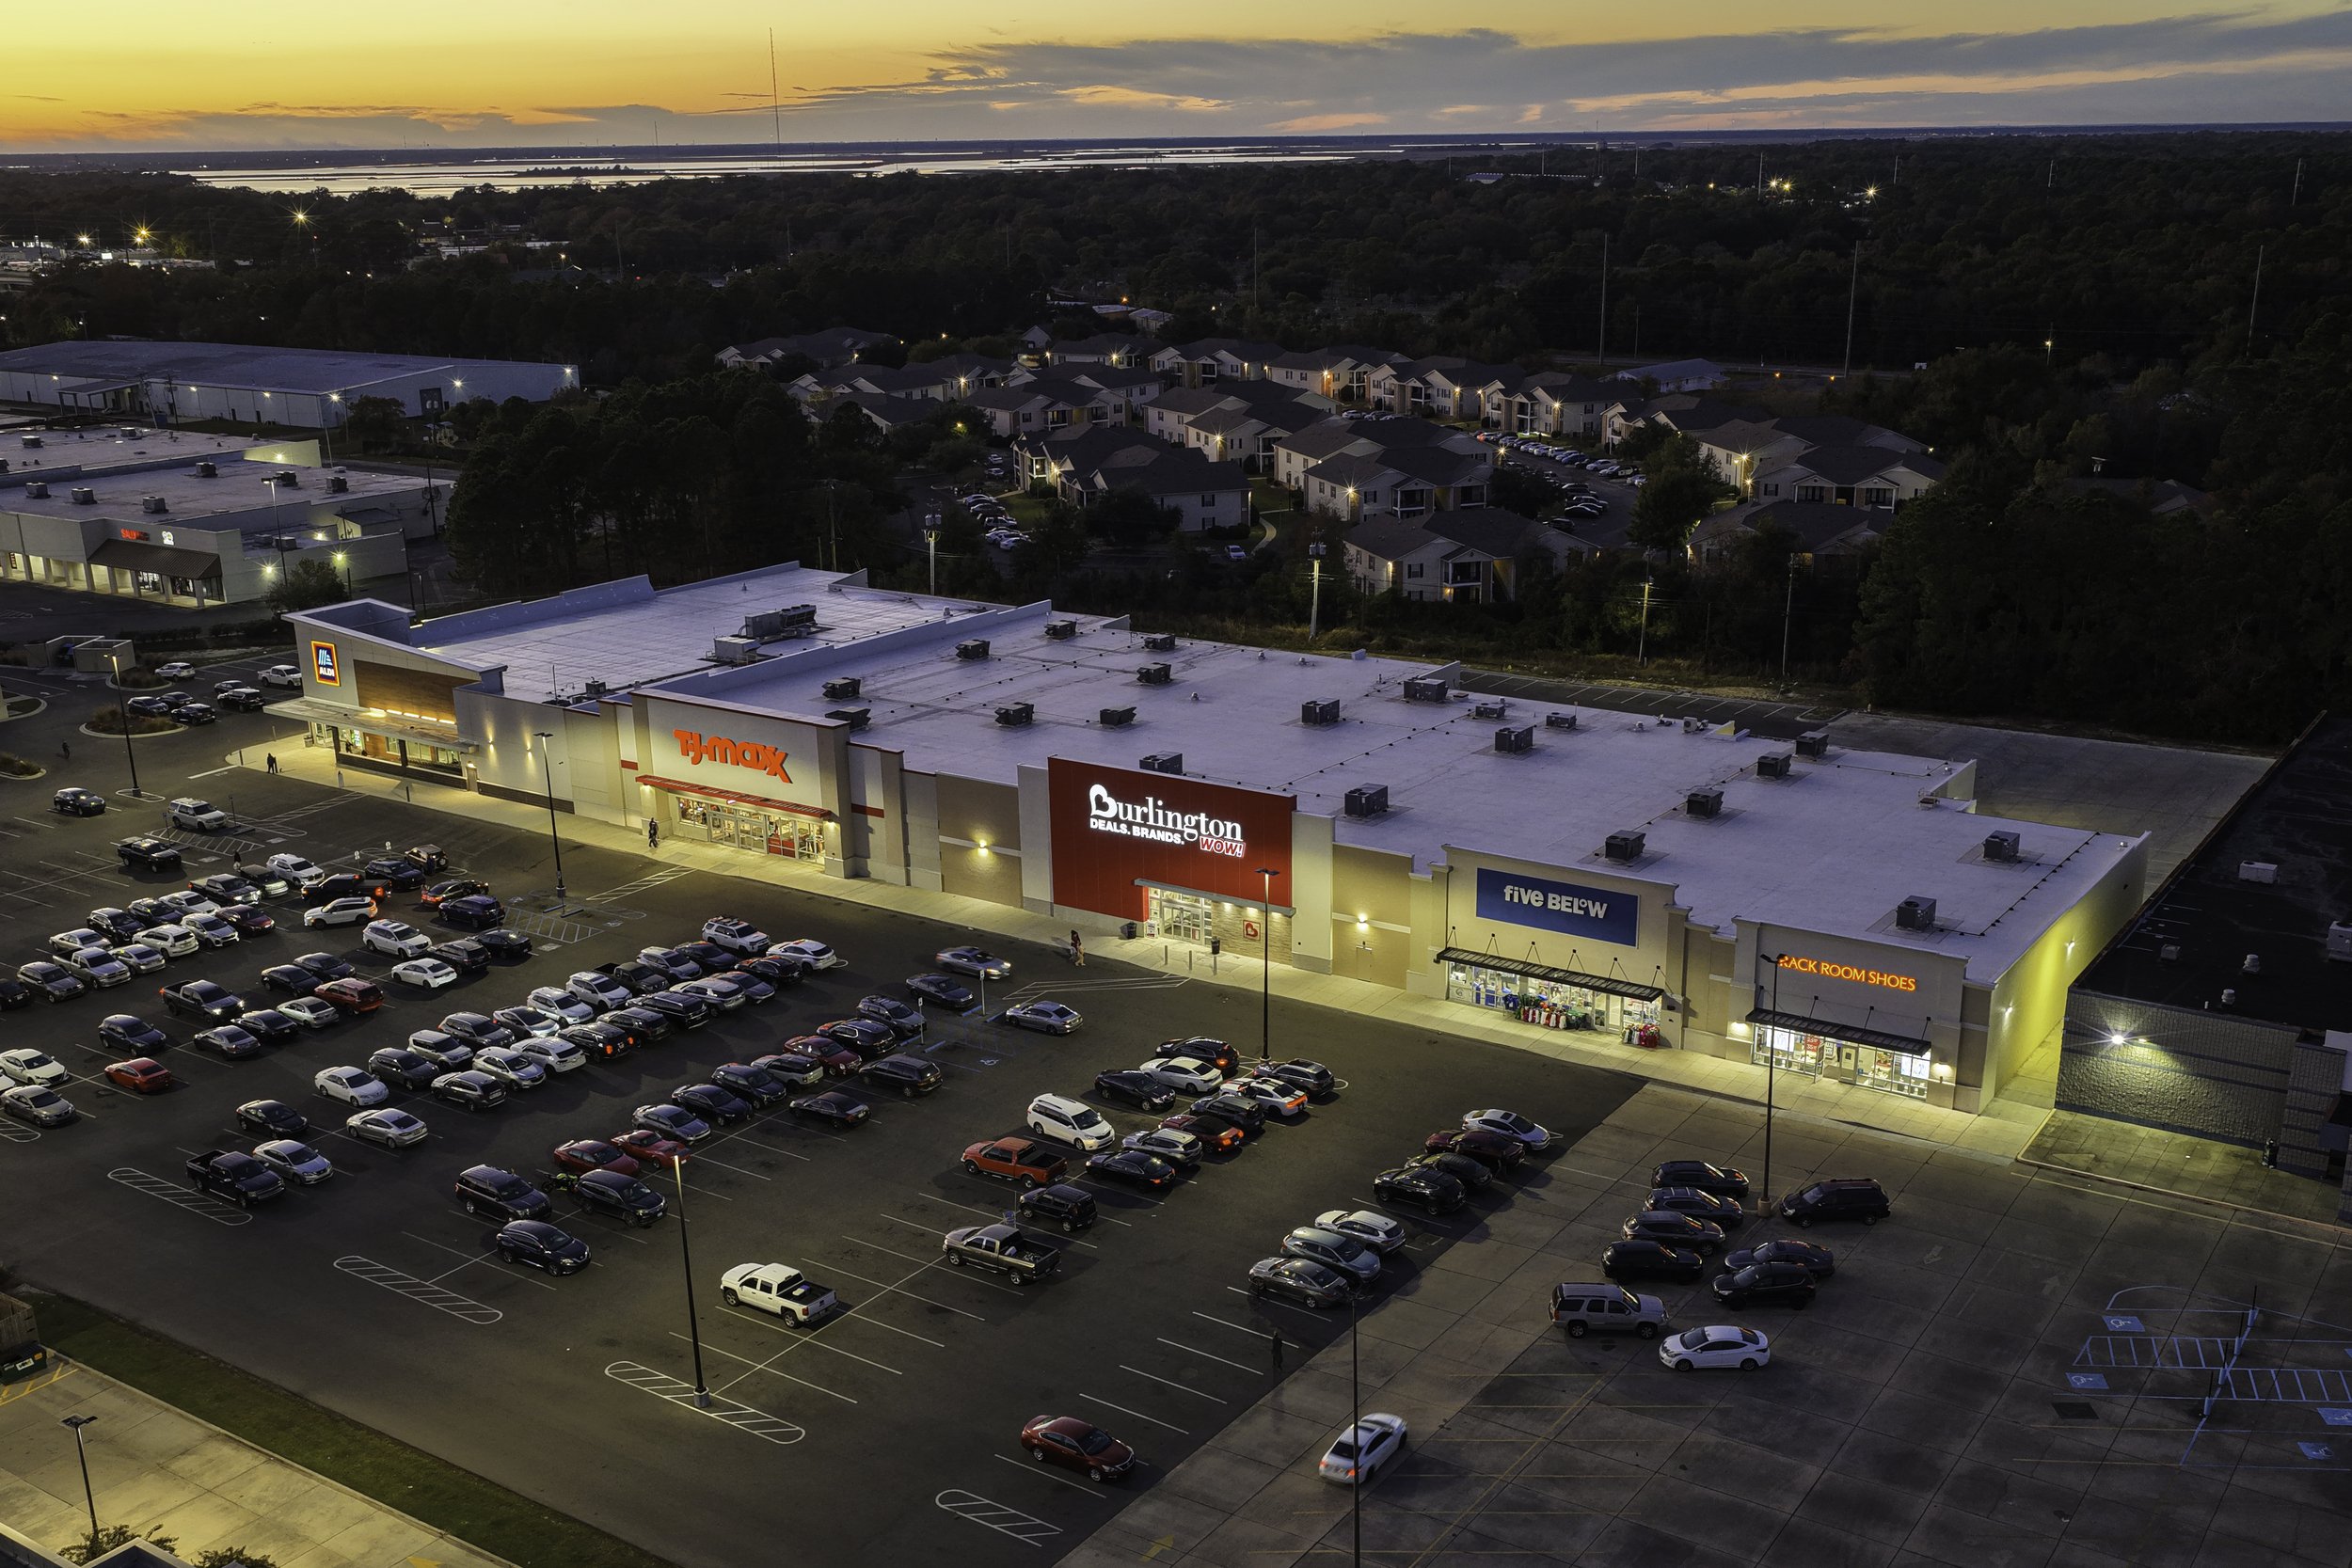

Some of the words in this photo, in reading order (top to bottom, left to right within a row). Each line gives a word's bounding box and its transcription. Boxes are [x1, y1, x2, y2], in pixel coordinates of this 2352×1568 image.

[319, 666, 335, 677] ALDI
[1089, 784, 1243, 841] Burlington
[1089, 817, 1131, 835] DEALS.
[1132, 827, 1184, 845] BRANDS.
[1199, 835, 1246, 858] WOW!
[1503, 885, 1544, 907] five
[1548, 893, 1608, 919] BELOW
[1820, 962, 1866, 982] ROOM
[1868, 971, 1916, 991] SHOES
